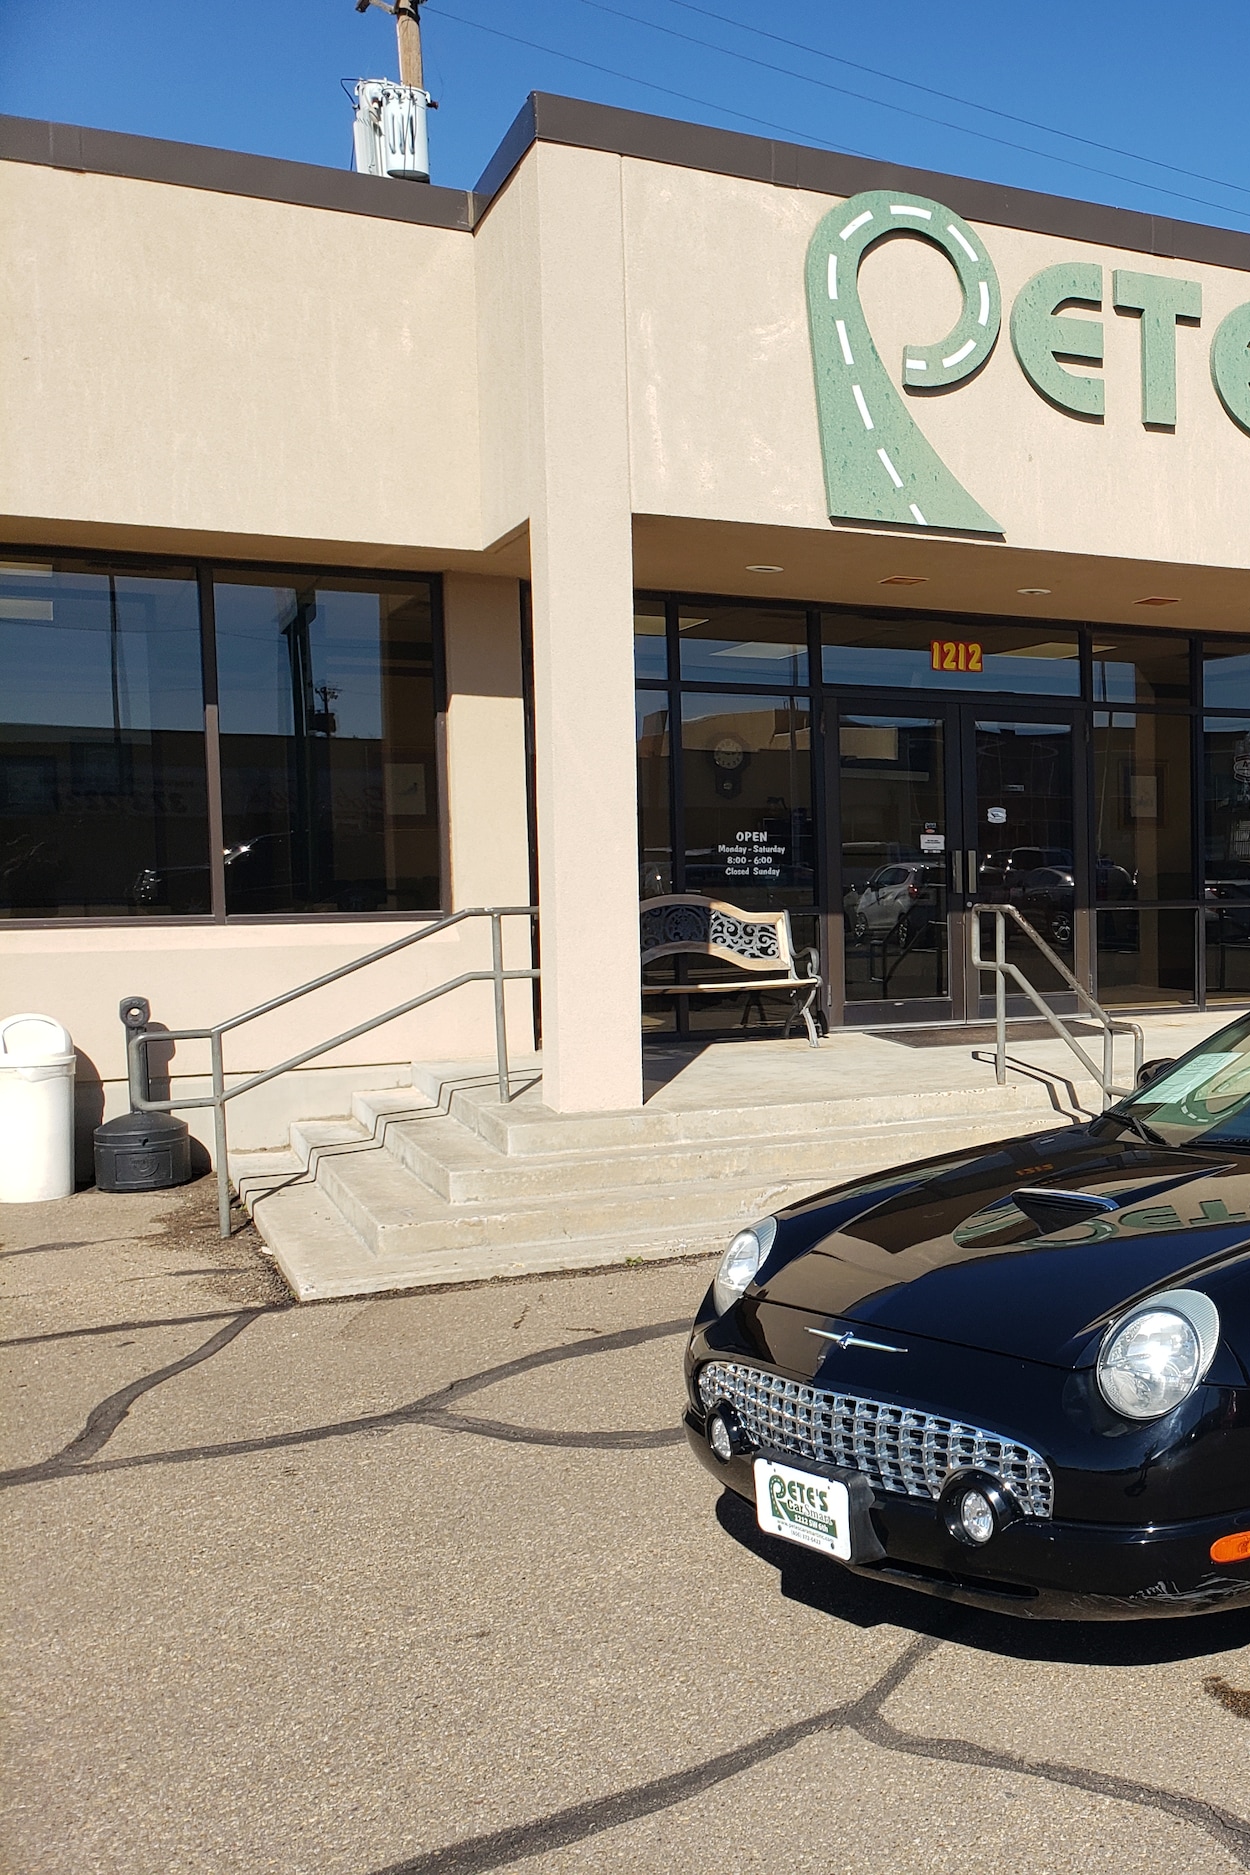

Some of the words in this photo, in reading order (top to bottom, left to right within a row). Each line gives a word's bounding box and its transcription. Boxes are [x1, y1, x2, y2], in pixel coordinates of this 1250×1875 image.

[932, 641, 982, 671] 1212
[735, 831, 768, 842] OPEN
[718, 844, 747, 855] Monday
[753, 845, 785, 855] Saturday
[727, 856, 747, 864] 8:00
[753, 856, 773, 865] 6:00
[725, 867, 750, 876] Closed
[753, 867, 780, 876] Sunday
[769, 1475, 829, 1520] PETE'S
[794, 1514, 809, 1527] 1212
